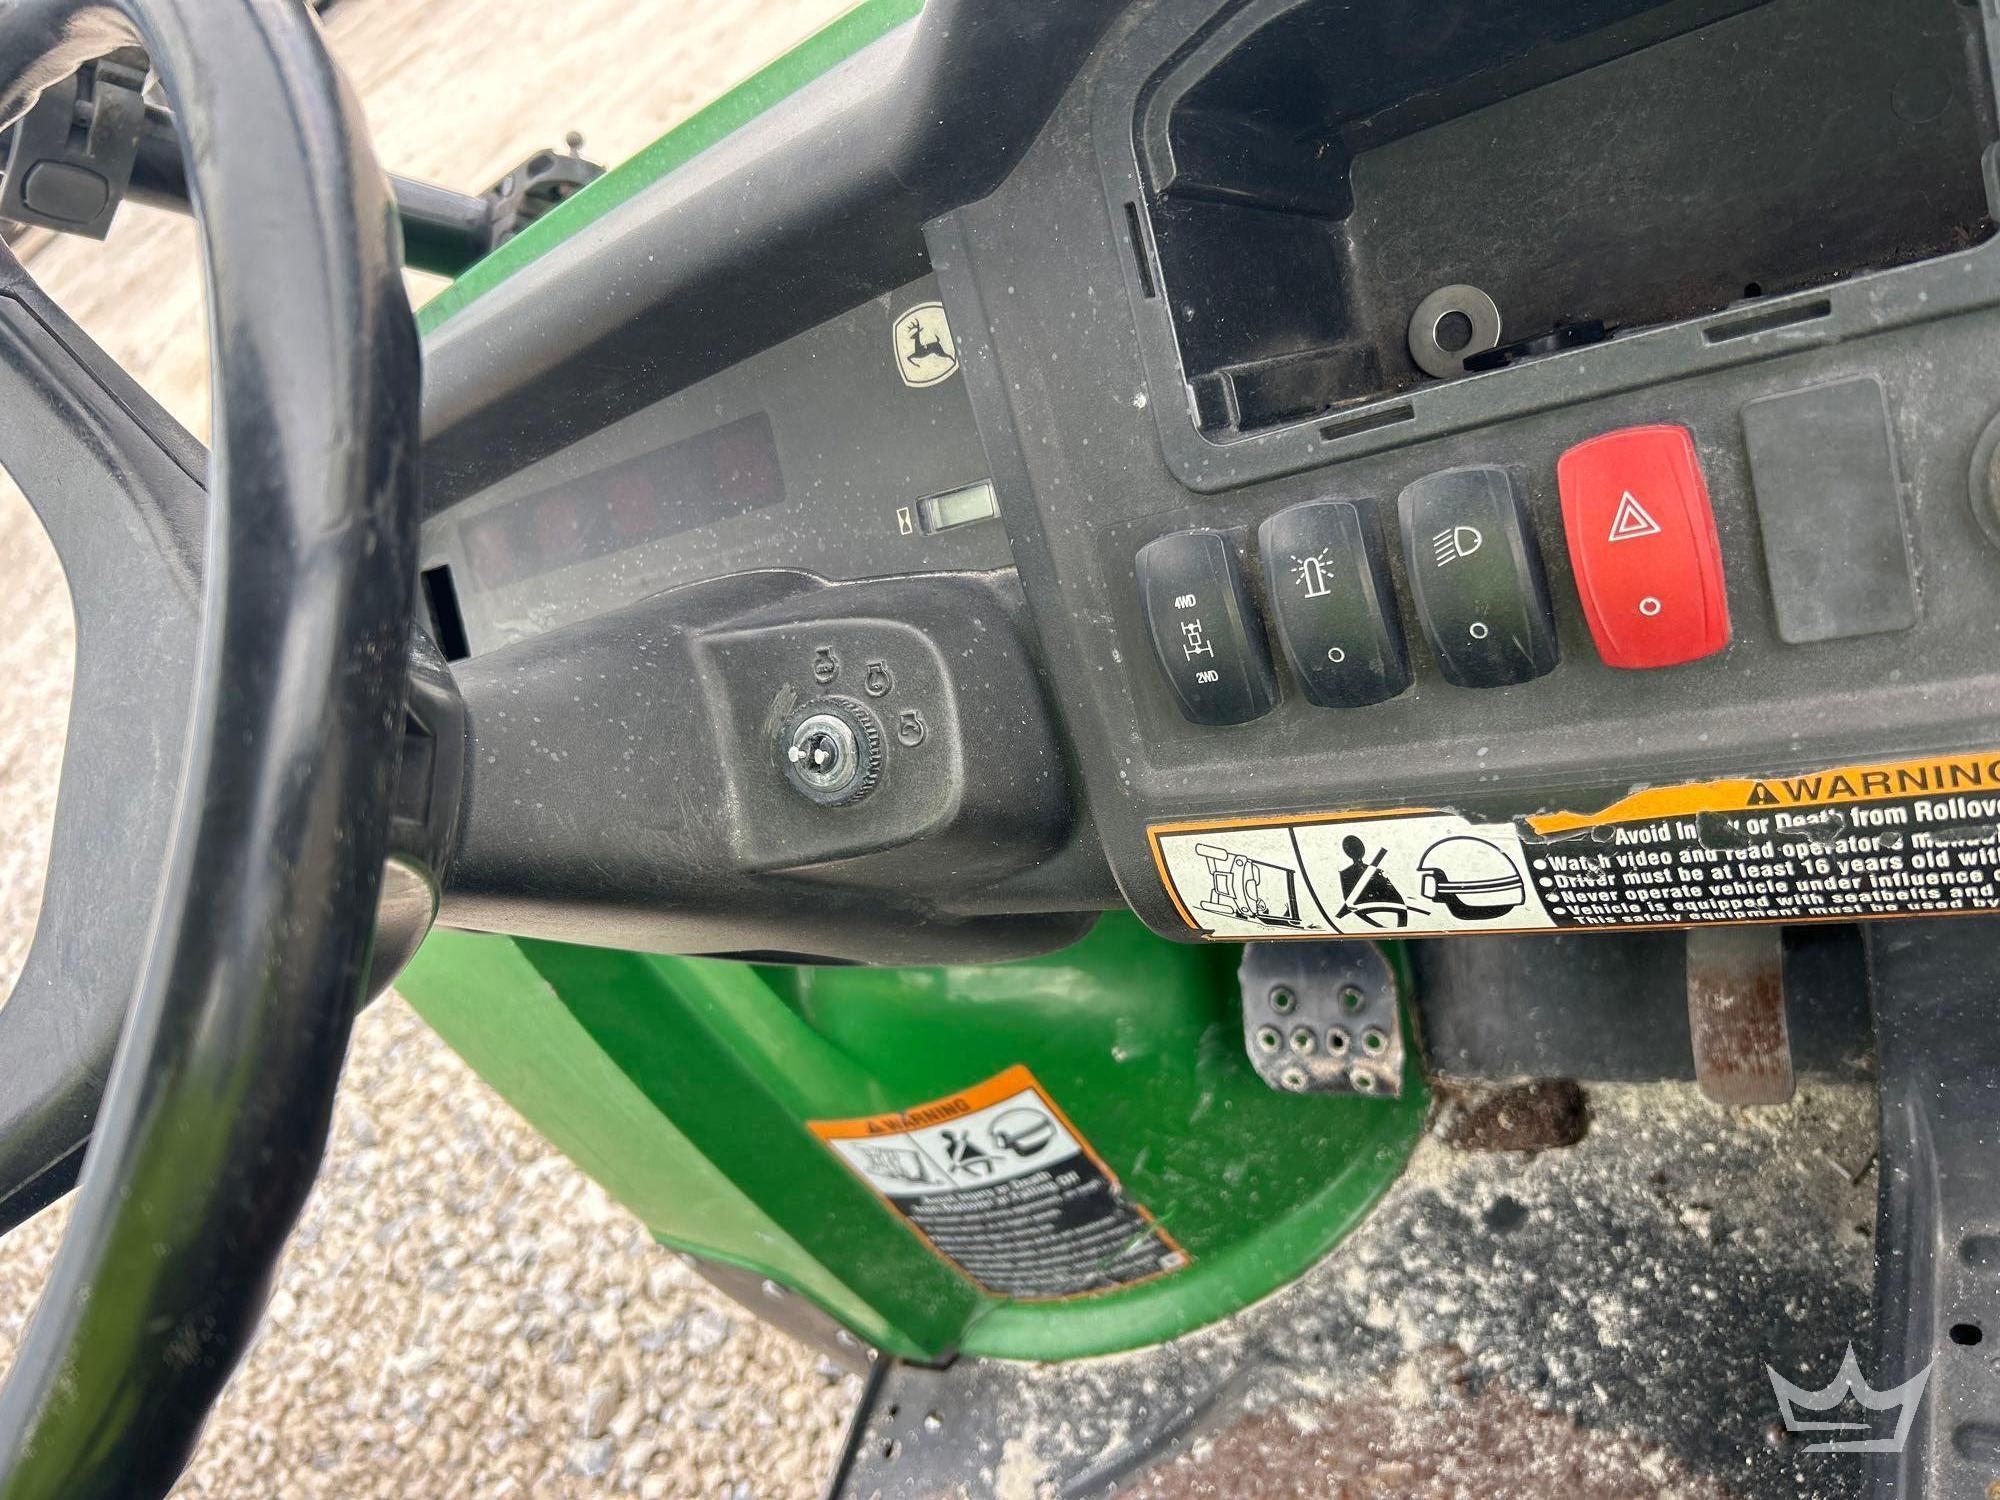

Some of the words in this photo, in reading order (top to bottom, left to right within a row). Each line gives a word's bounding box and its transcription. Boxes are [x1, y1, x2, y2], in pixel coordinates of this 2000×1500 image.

[1175, 594, 1196, 609] 4WD
[1196, 670, 1219, 684] 2WD
[1615, 821, 1671, 845] Avoid
[1746, 818, 1769, 835] or
[1850, 806, 1908, 827] from
[1914, 797, 2000, 823] Rollov
[1616, 850, 1673, 867] video
[1725, 841, 1775, 861] read
[1554, 873, 1616, 889] Driver
[1622, 868, 1673, 885] must
[1678, 866, 1704, 882] be
[1710, 864, 1733, 880] at
[1738, 860, 1795, 878] least
[1801, 858, 1831, 875] 16
[1837, 856, 1904, 875] years
[1911, 850, 1950, 869] old
[1561, 889, 1618, 904] Never
[1624, 884, 1703, 901] operate
[1708, 879, 1788, 896] vehicle
[1796, 875, 1862, 892] under
[1869, 869, 1984, 889] influence
[1567, 902, 1641, 915] Vehicle
[1647, 901, 1667, 912] is
[1672, 895, 1770, 912] equipped
[1775, 893, 1825, 906] with
[1832, 887, 1941, 904] seatbelts
[1950, 884, 1995, 898] and
[1573, 915, 1616, 925] This
[1622, 912, 1681, 923] safety
[1688, 906, 1800, 920] equipment
[1808, 903, 1863, 915] must
[1870, 902, 1899, 912] be
[1907, 899, 1963, 911] used
[1972, 897, 2000, 909] by
